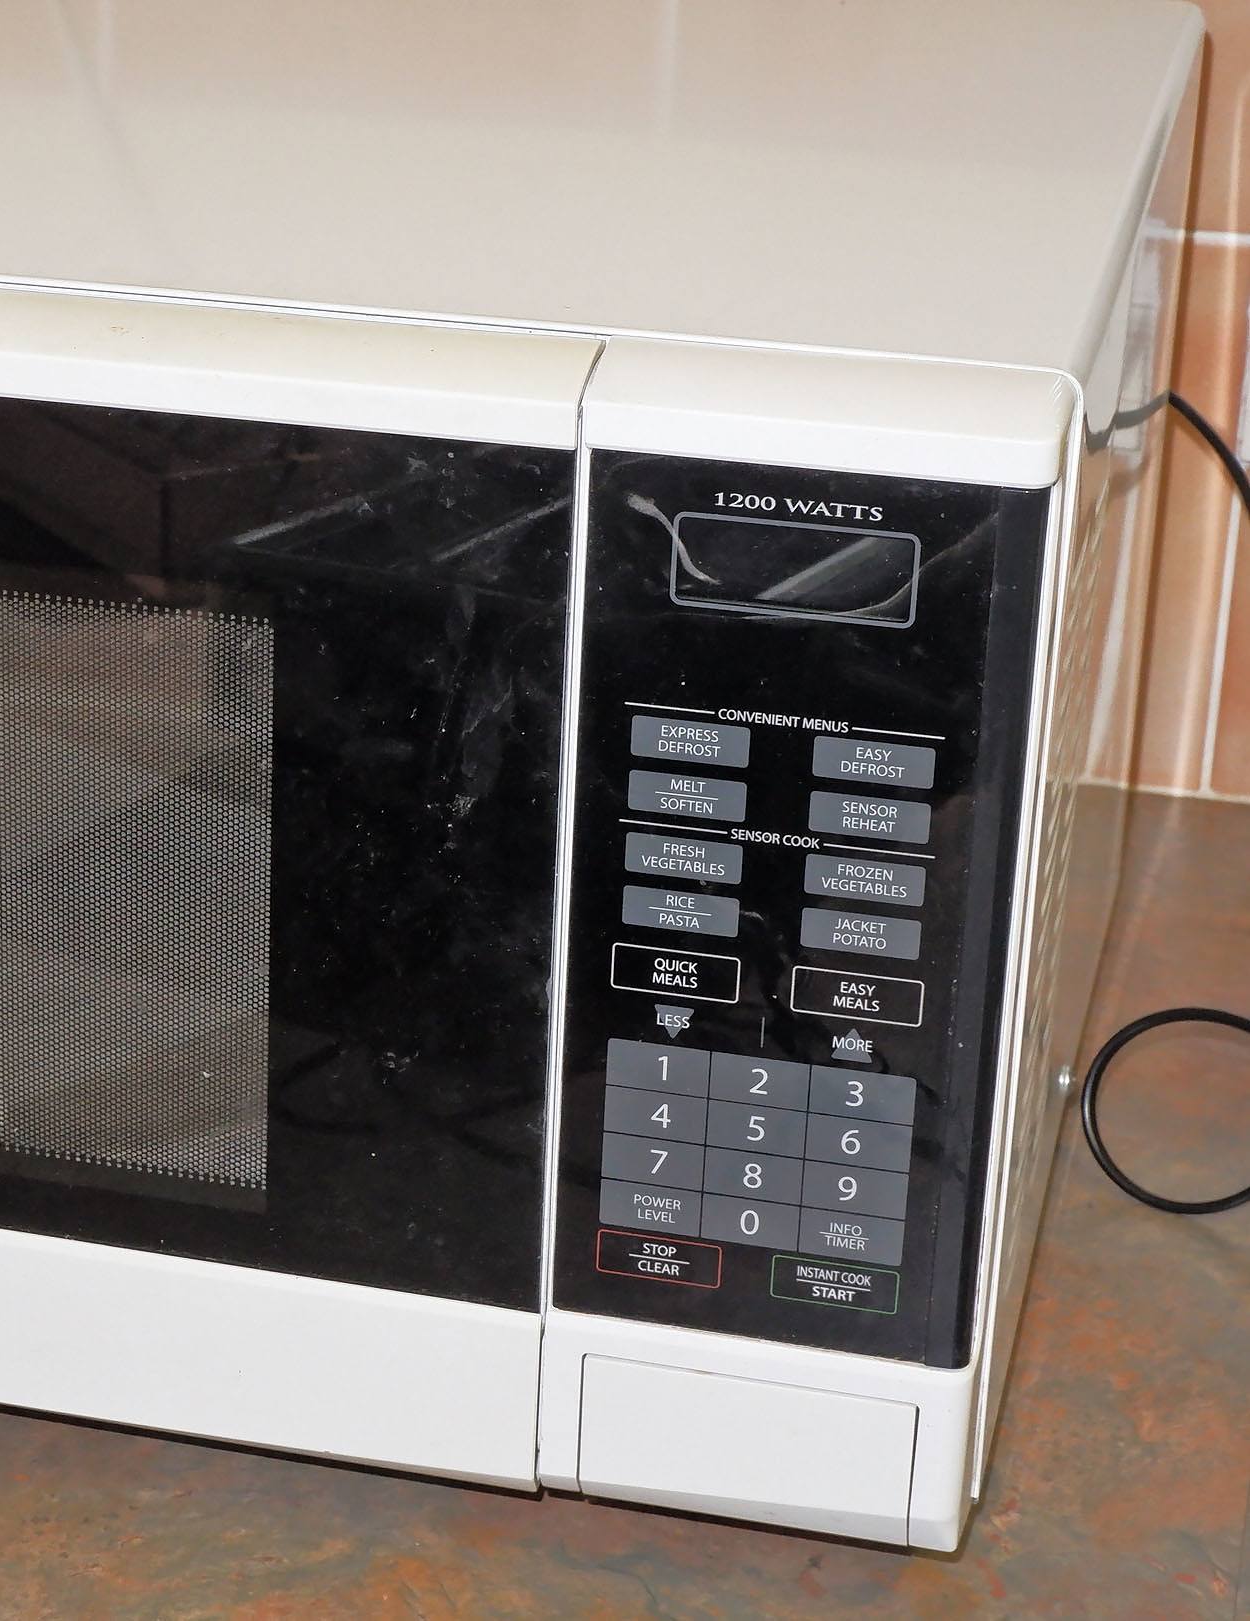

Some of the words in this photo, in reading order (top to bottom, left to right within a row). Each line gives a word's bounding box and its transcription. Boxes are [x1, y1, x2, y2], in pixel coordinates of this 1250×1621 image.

[714, 492, 776, 511] 1200
[784, 498, 884, 522] WATTS
[718, 708, 800, 728] CONVENIENT
[802, 717, 849, 733] MENUS
[661, 725, 719, 743] EXPRESS
[658, 739, 721, 758] DEFROST
[855, 747, 892, 762] EASY
[840, 760, 905, 779] DEFROST
[670, 779, 706, 793] MELT
[660, 797, 713, 815] SOFTEN
[842, 801, 898, 819] SENSOR
[843, 816, 896, 833] REHEAT
[730, 828, 780, 845] SENSOR
[783, 834, 820, 849] COOK
[662, 843, 705, 858] FRESH
[641, 856, 725, 876] VEGETABLES
[838, 864, 893, 881] FROZEN
[821, 877, 907, 898] VEGETABLES
[666, 894, 695, 909] RICE
[659, 913, 700, 929] PASTA
[835, 918, 886, 935] JACKET
[832, 933, 886, 950] POTATO
[654, 957, 698, 975] QUICK
[652, 971, 698, 989] MEALS
[840, 980, 875, 997] EASY
[833, 994, 880, 1012] MEALS
[657, 1013, 689, 1030] LESS
[832, 1036, 873, 1053] MORE
[659, 1055, 668, 1081] 1
[750, 1069, 768, 1094] 2
[846, 1081, 864, 1107] 3
[650, 1104, 671, 1128] 4
[747, 1116, 765, 1141] 5
[841, 1130, 861, 1155] 6
[650, 1149, 668, 1175] 7
[743, 1164, 762, 1189] 8
[839, 1176, 857, 1201] 9
[634, 1194, 681, 1211] POWER
[638, 1208, 675, 1224] LEVEL
[740, 1210, 759, 1235] 0
[829, 1221, 862, 1237] INFO
[643, 1242, 677, 1257] STOP
[825, 1235, 865, 1251] TIMER
[638, 1260, 679, 1276] CLEAR
[796, 1265, 840, 1283] INSTANT
[842, 1272, 871, 1287] COOK
[812, 1285, 855, 1302] START
